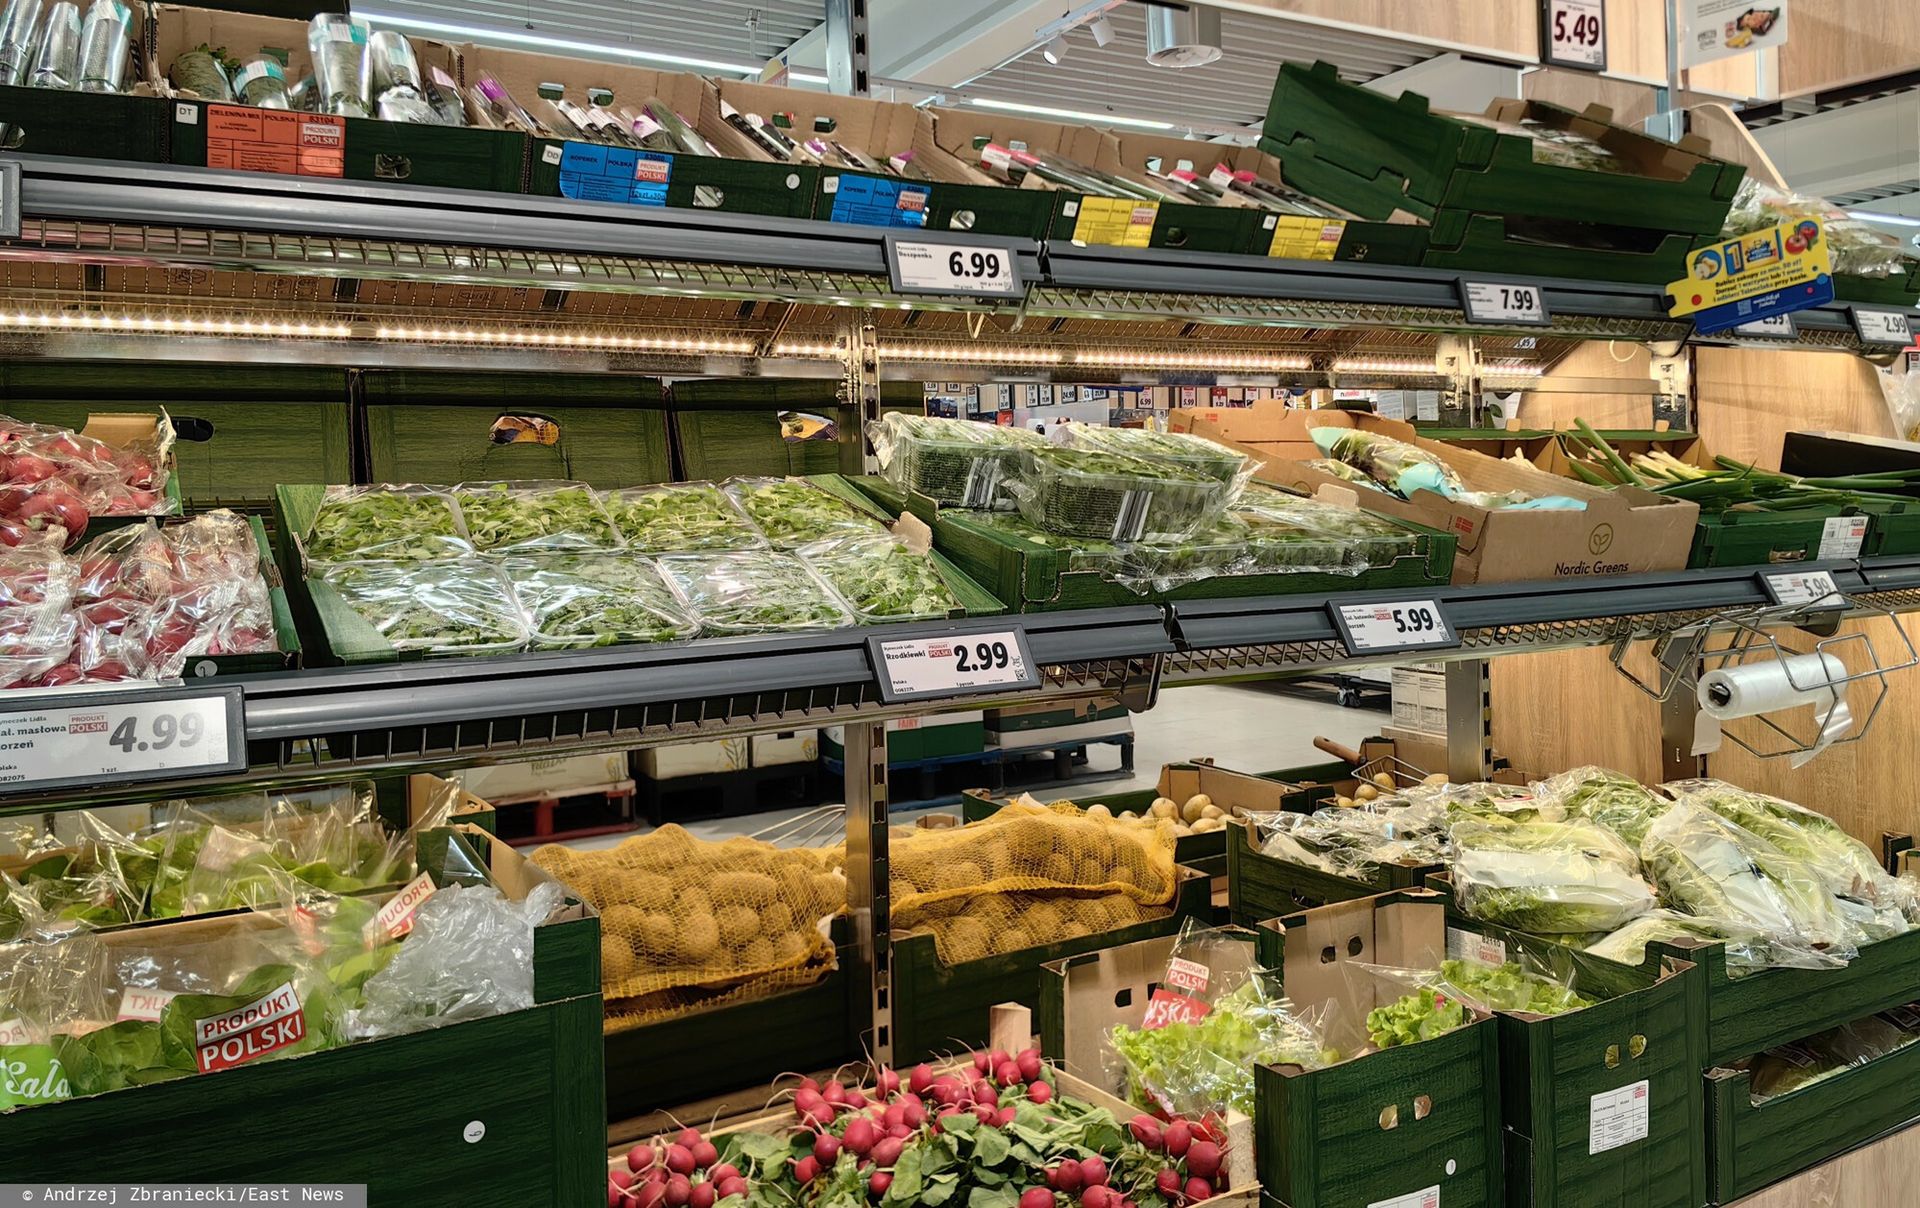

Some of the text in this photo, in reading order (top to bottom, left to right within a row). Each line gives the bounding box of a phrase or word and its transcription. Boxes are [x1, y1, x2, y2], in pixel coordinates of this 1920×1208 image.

[1554, 11, 1599, 46] 5.49
[179, 107, 192, 115] DT
[210, 109, 246, 119] ZIELENINA
[264, 114, 296, 122] POLSKA
[309, 116, 334, 124] 83104
[305, 125, 338, 135] PRODUKT
[304, 135, 338, 145] POLSKI
[546, 151, 559, 159] DD
[608, 160, 633, 168] POLSKA
[640, 162, 666, 171] PRODUKT
[637, 170, 666, 180] POLSKI
[899, 200, 923, 209] POLSKI
[949, 251, 1000, 278] 6.99
[1500, 289, 1533, 311] 7.99
[1883, 316, 1907, 333] 2.99
[1183, 398, 1195, 406] 5.99
[1554, 561, 1628, 576] Nordic Greens
[1802, 577, 1832, 597] 5.99
[1392, 608, 1434, 633] 5.99
[886, 650, 926, 660] Rzodkiewki
[929, 649, 952, 658] POLSKI
[954, 642, 1009, 672] 2.99
[71, 715, 106, 723] PRODUKT
[898, 718, 918, 729] FAIRY
[17, 726, 67, 735] masłowa
[69, 723, 108, 733] POLSKI
[109, 712, 205, 753] 4.99
[1, 740, 34, 750] orzeń
[1174, 960, 1207, 975] PRODUKT
[1170, 971, 1207, 991] POLSKI
[203, 991, 292, 1038] PRODUKT
[202, 1014, 302, 1071] POLSKI
